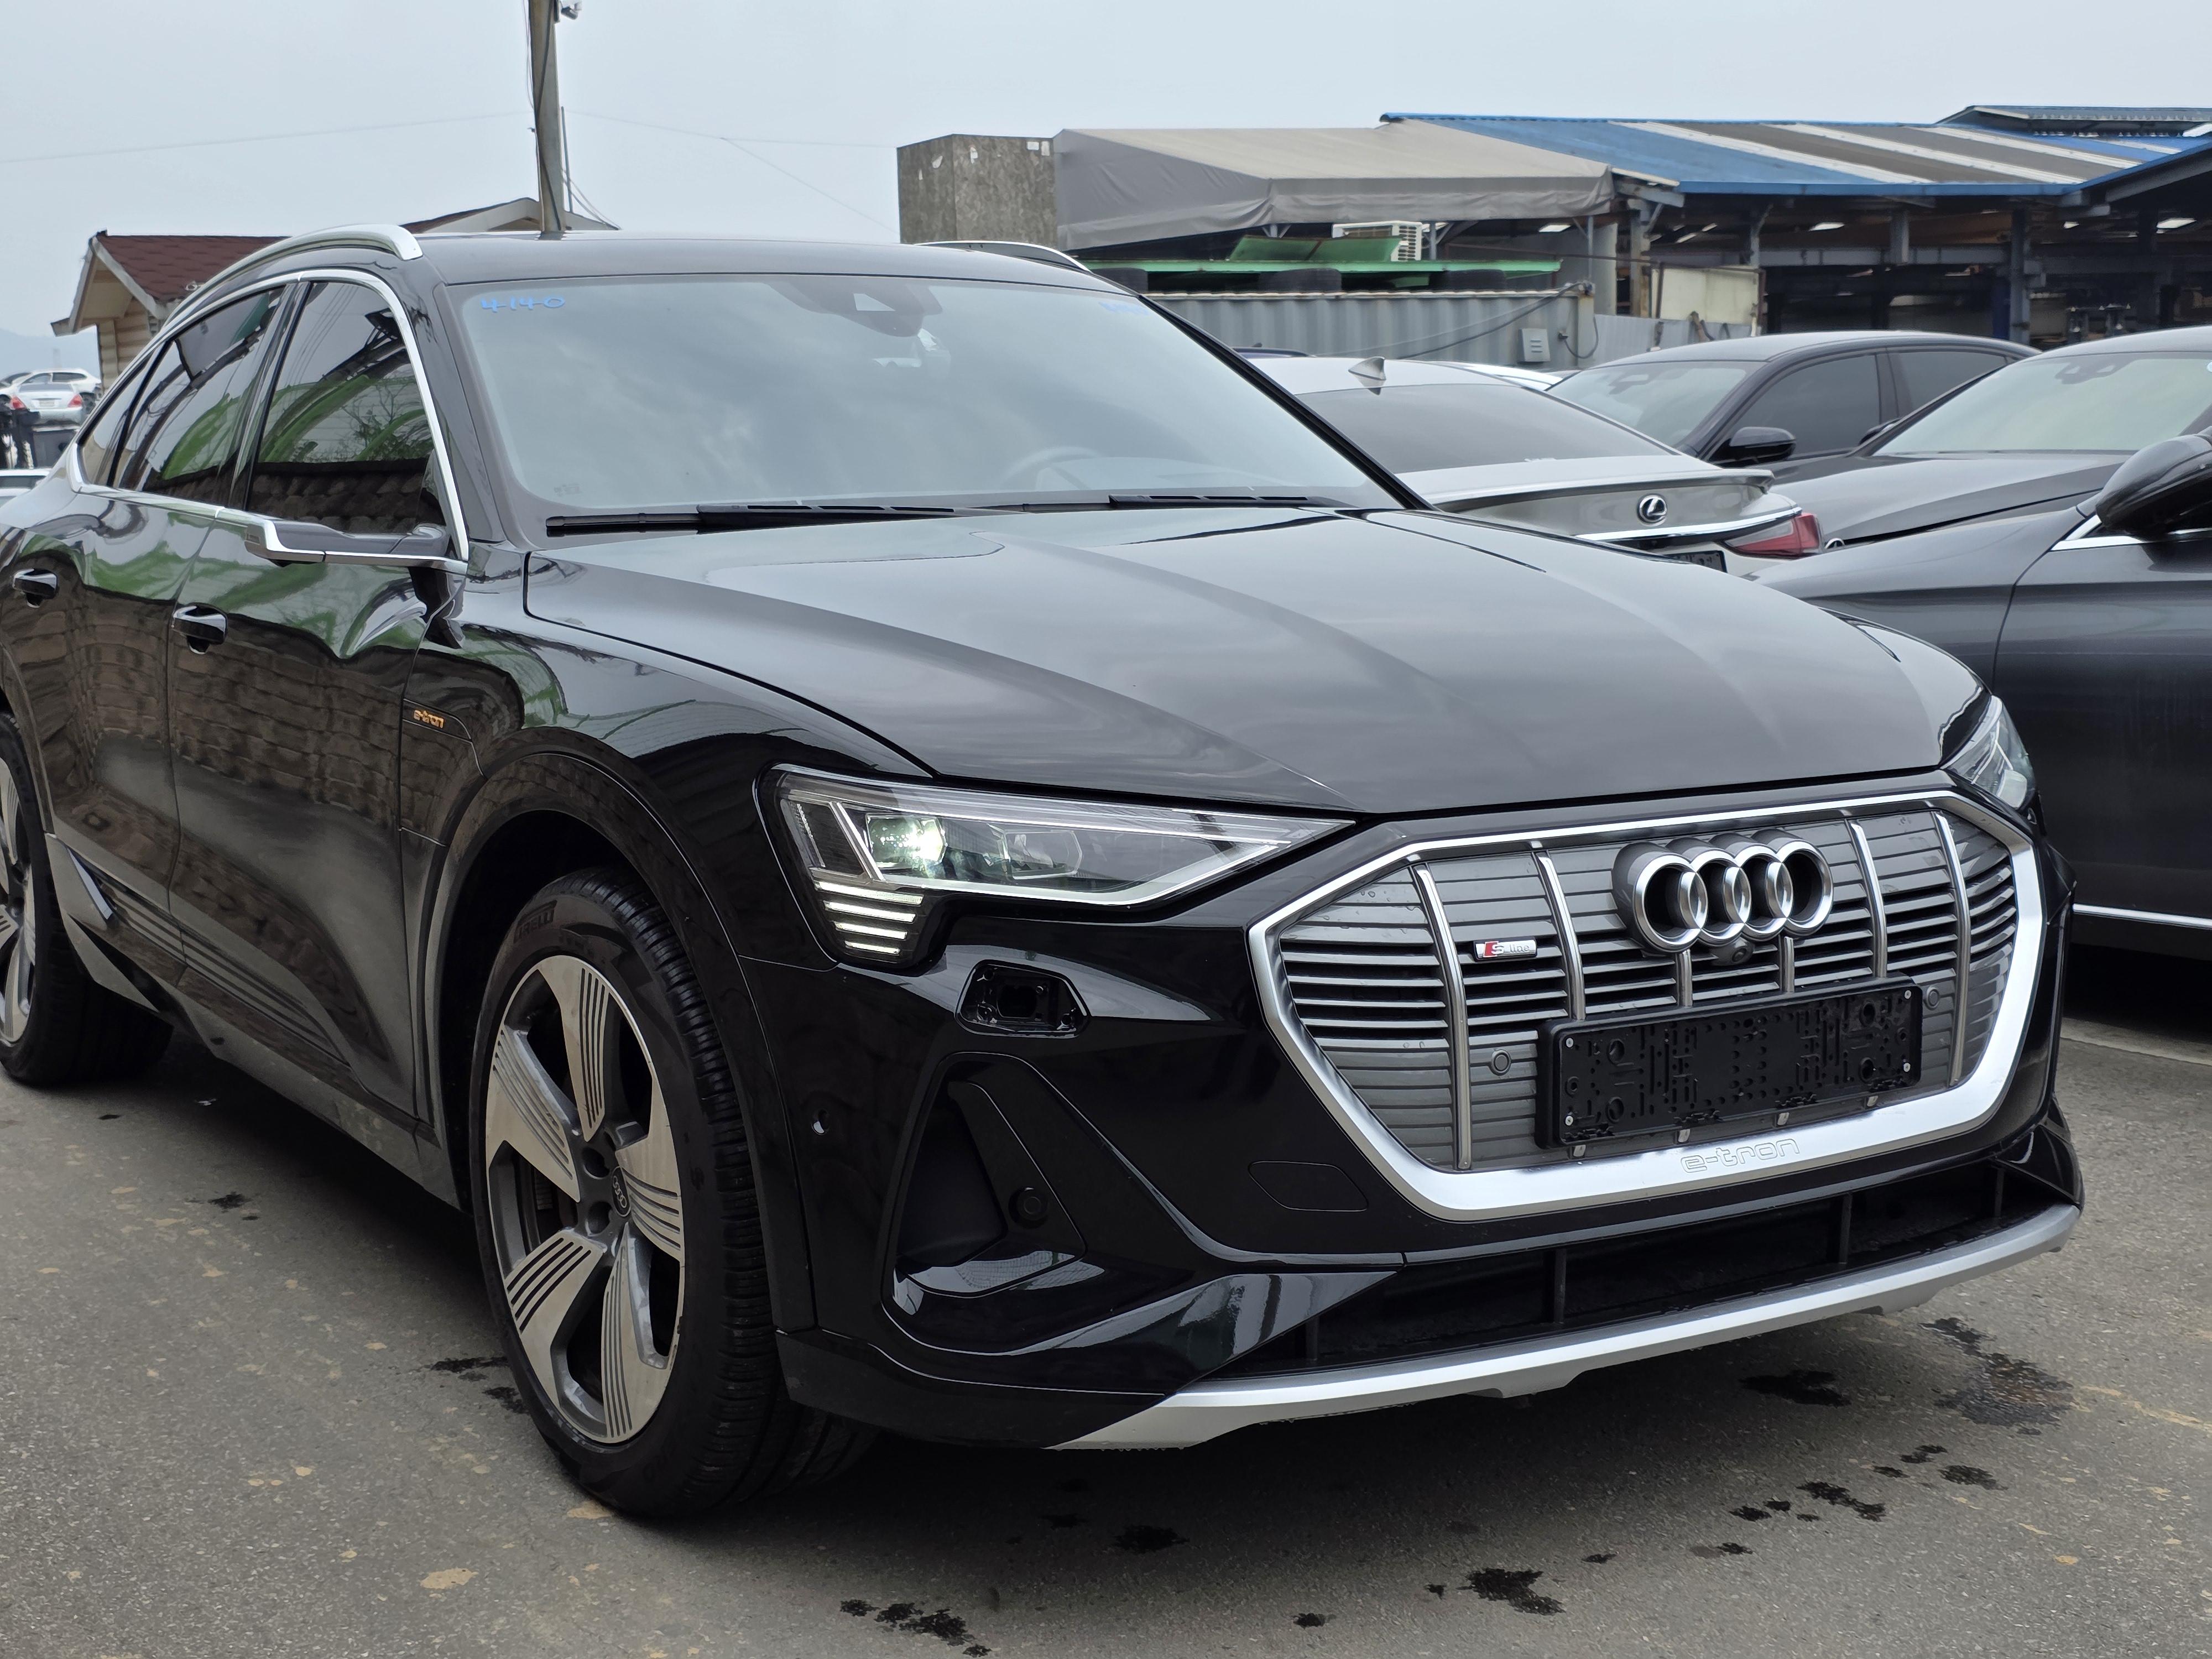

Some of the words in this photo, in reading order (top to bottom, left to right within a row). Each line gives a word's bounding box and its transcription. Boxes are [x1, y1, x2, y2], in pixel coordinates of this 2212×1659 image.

[480, 296, 566, 314] 4140
[1509, 943, 1531, 953] line
[1680, 1138, 1801, 1173] e-tron
